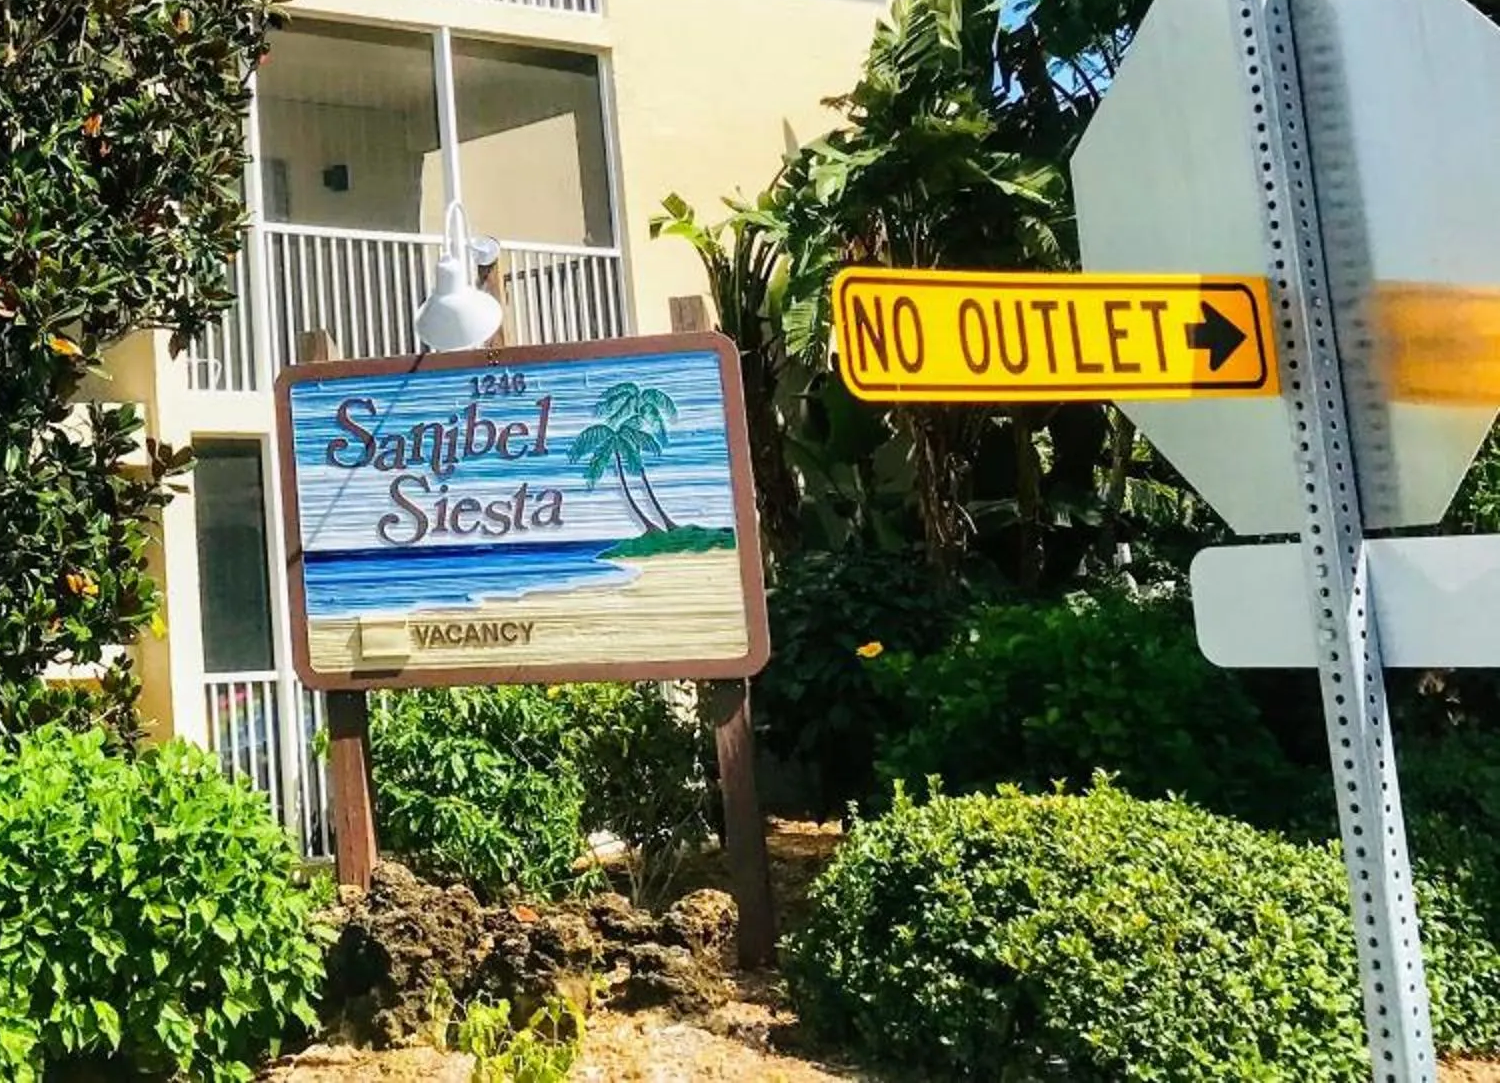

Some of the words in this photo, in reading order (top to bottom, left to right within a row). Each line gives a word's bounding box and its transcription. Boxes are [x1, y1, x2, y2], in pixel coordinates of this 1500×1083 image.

[852, 295, 925, 374] NO
[959, 298, 1169, 374] OUTLET
[470, 373, 527, 398] 1246
[328, 396, 553, 478] Sanibel
[378, 474, 564, 546] Siesta
[414, 621, 534, 648] VACANCY
